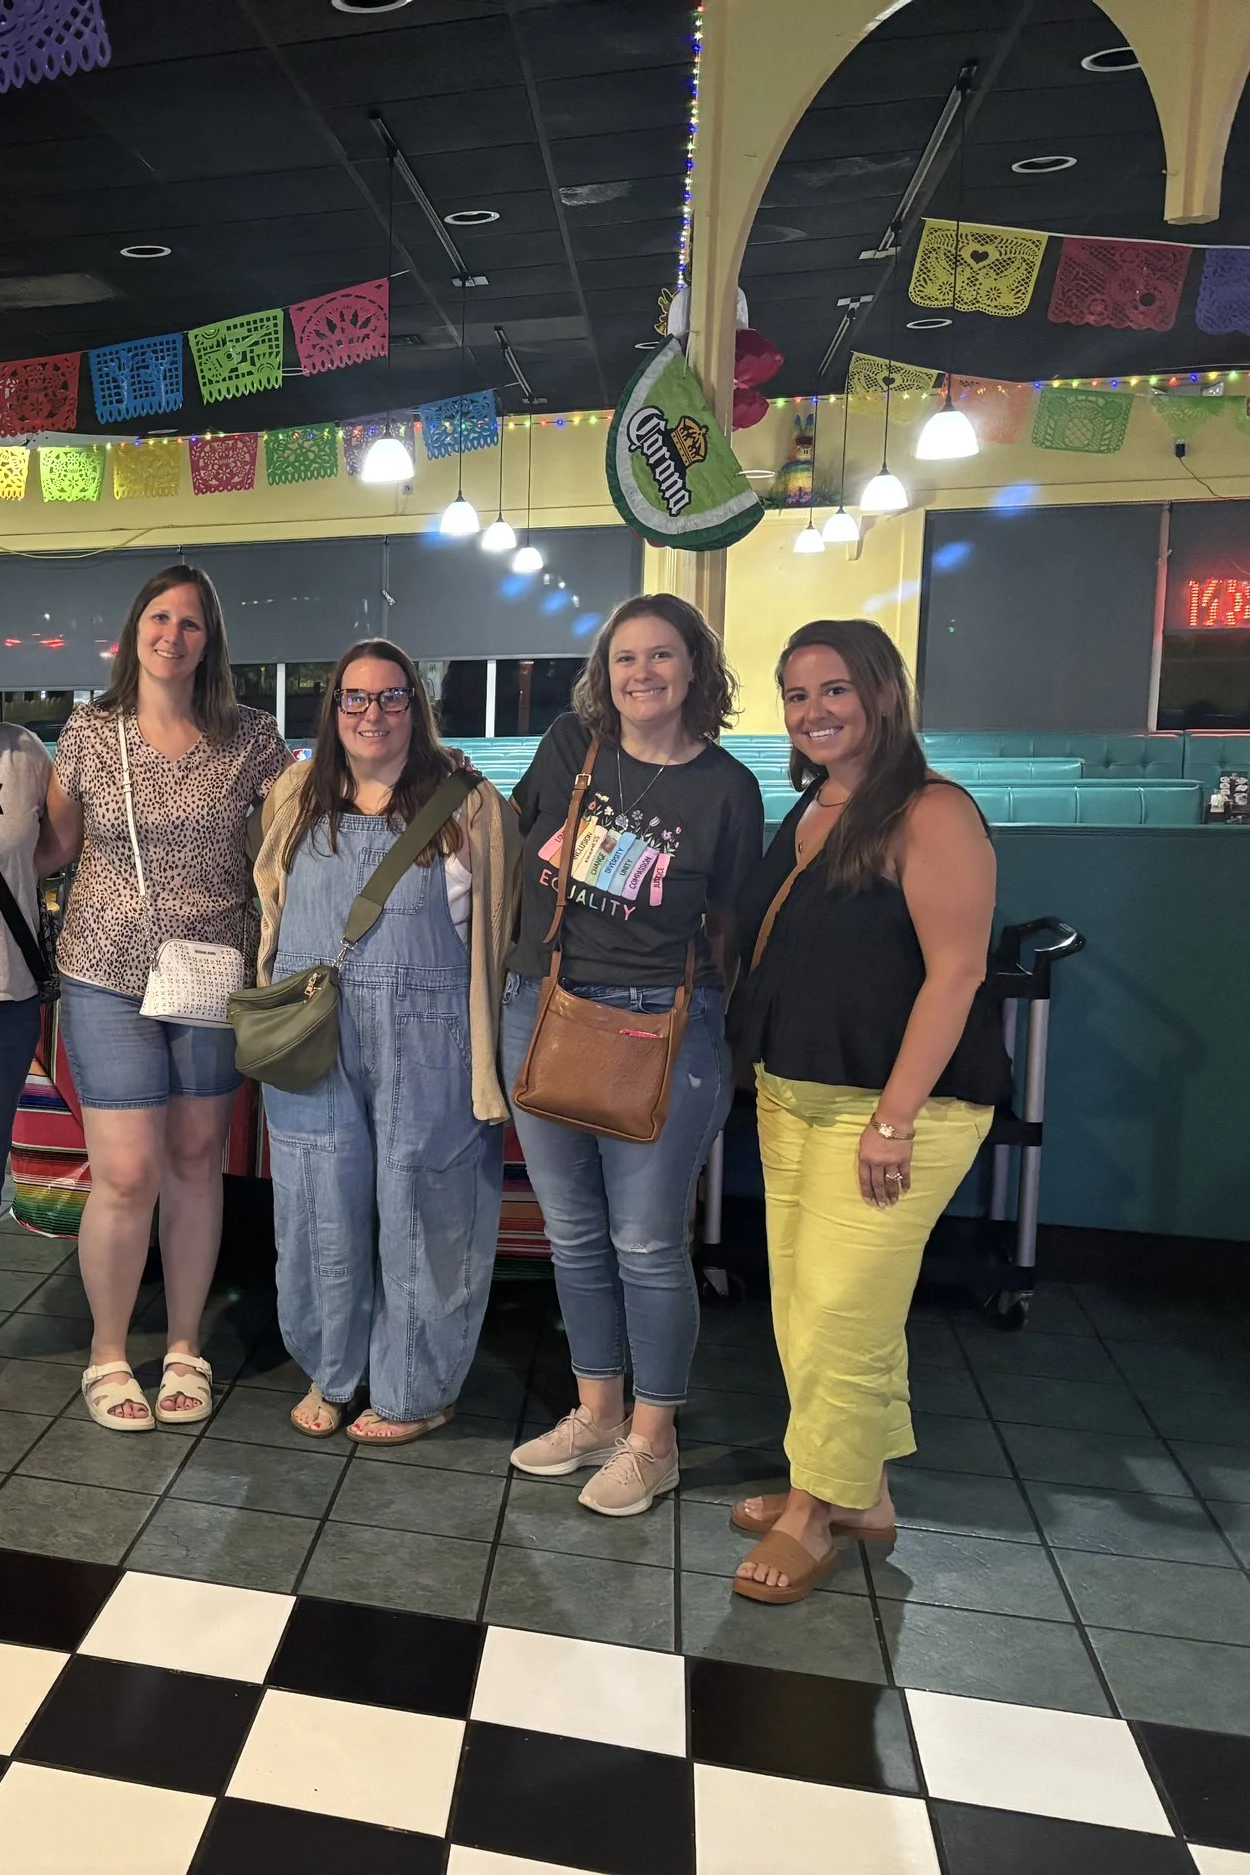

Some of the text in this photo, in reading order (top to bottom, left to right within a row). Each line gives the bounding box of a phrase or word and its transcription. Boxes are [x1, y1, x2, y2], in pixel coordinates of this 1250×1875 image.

[626, 405, 692, 517] Corona
[590, 852, 606, 876] CHANGE
[604, 847, 625, 874] DIVERSITY
[619, 859, 633, 876] UNITY
[628, 856, 653, 890] COMPASSION
